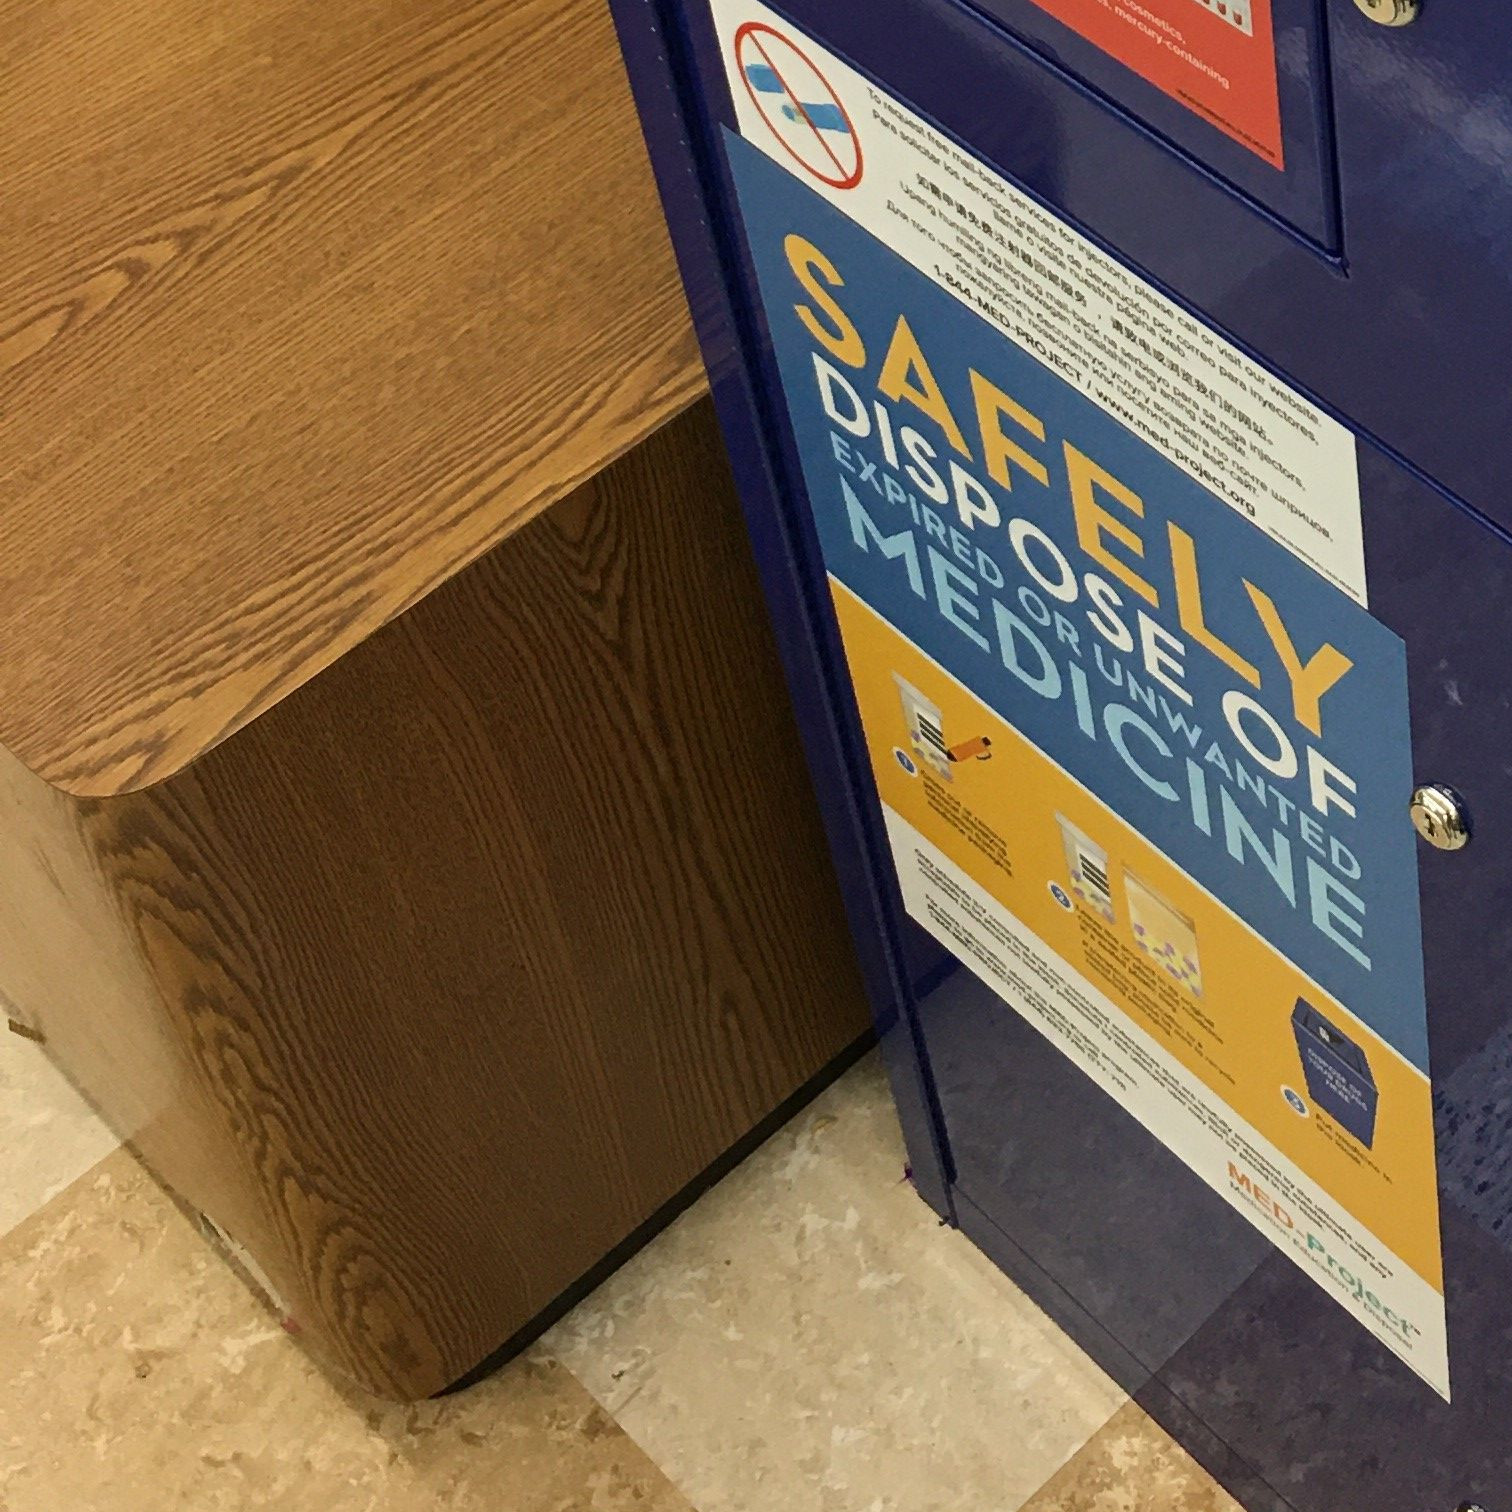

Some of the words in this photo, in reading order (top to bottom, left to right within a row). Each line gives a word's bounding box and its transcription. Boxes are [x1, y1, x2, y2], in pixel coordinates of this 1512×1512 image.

[866, 87, 882, 106] To
[883, 102, 926, 138] request
[926, 131, 950, 156] free
[952, 152, 1007, 197] mail-back
[1008, 193, 1057, 234] services
[1058, 227, 1075, 246] for
[1077, 242, 1132, 290] injectors,
[1134, 285, 1175, 320] please
[1177, 316, 1199, 337] call
[1200, 334, 1214, 348] or
[1216, 345, 1242, 370] visit
[1244, 366, 1266, 386] our
[1268, 383, 1321, 427] website.
[934, 265, 1081, 382] 1-844-MED-PROJECT
[1095, 388, 1256, 517] www.med-project.org
[784, 235, 1353, 738] SAFELY
[812, 353, 1193, 707] DISPOSE
[1222, 691, 1358, 820] OF
[831, 431, 1004, 589] EXPIRED
[1018, 587, 1082, 657] OR
[1094, 645, 1361, 880] UNWANTED
[840, 475, 1372, 972] MEDICINE
